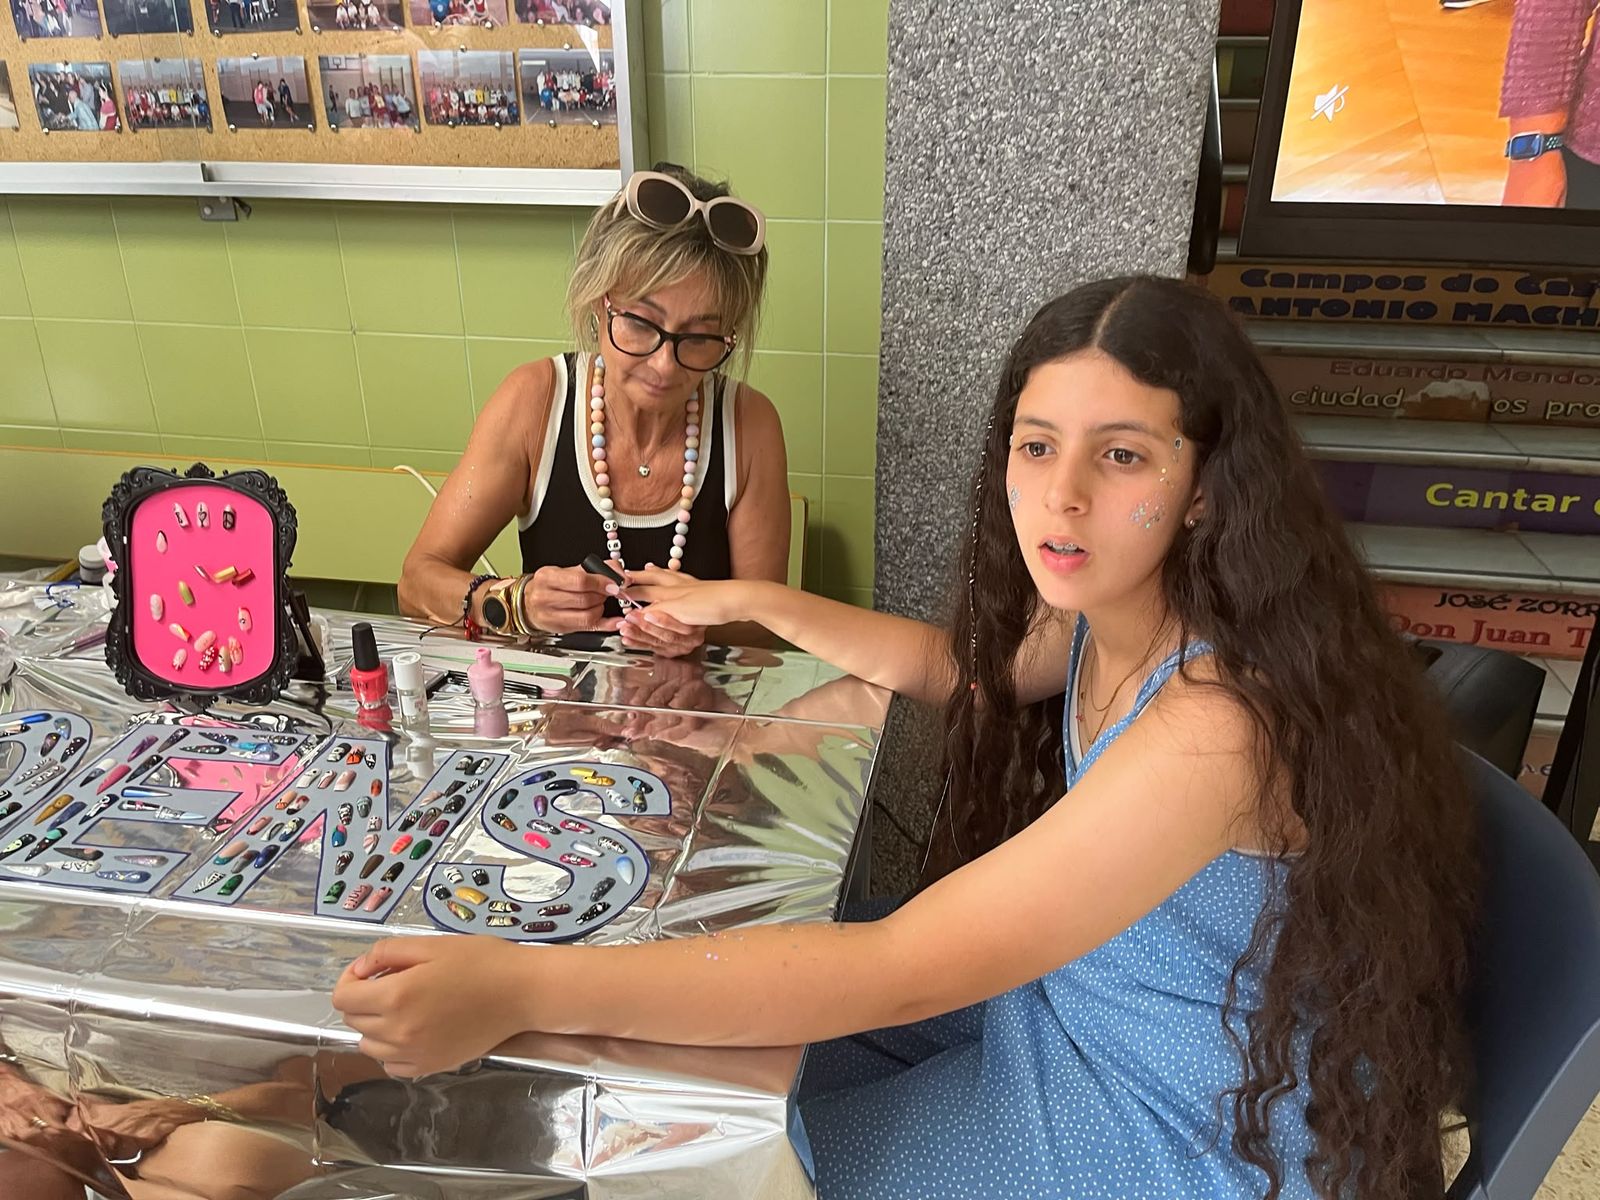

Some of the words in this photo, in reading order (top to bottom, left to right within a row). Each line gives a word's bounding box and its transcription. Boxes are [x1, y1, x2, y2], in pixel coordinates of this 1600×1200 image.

[1240, 268, 1427, 293] Campos
[1229, 296, 1438, 321] ANTONIO
[1452, 302, 1600, 326] MACH
[1330, 360, 1469, 380] Eduardo
[1290, 386, 1405, 408] ciudad
[1493, 399, 1528, 414] os
[1425, 483, 1582, 514] Cantar
[1434, 592, 1512, 611] JOSÉ
[1471, 620, 1551, 645] Juan
